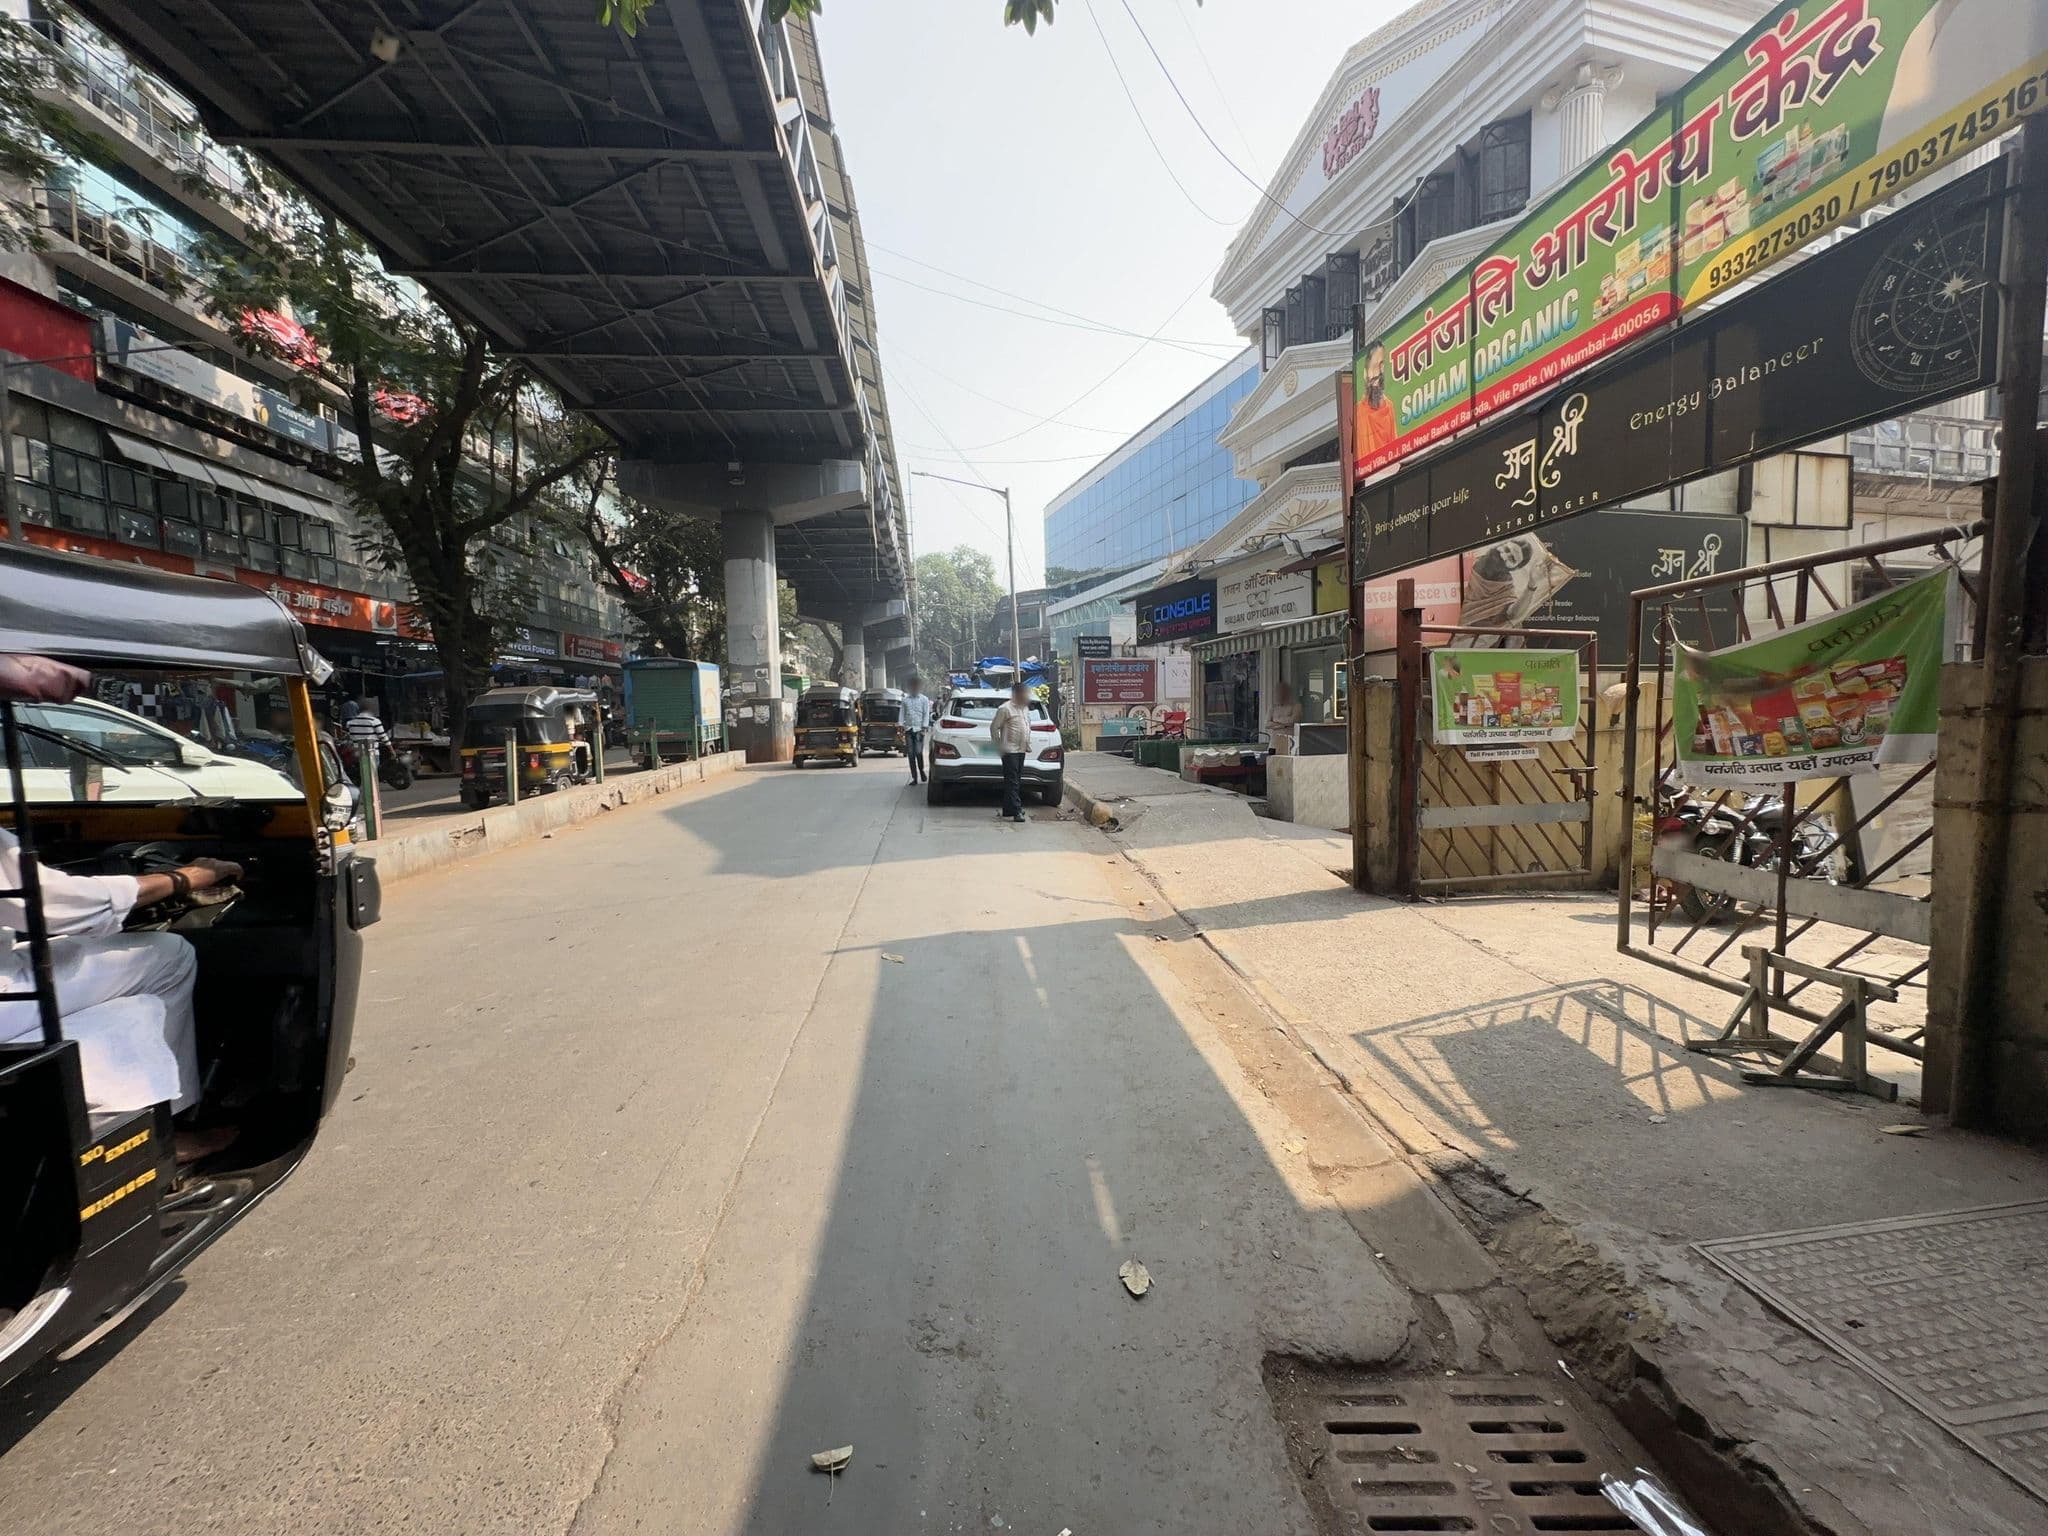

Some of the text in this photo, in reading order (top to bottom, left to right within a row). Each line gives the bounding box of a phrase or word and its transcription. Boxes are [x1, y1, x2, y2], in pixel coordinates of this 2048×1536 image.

[1390, 254, 1520, 386] पतंजलि
[1522, 98, 1725, 288] आरोग्य
[1709, 199, 1841, 290] 9332273030
[1400, 287, 1579, 426] SOHAM ORGANIC
[1413, 429, 1430, 446] Near
[1430, 418, 1450, 440] Bank
[1460, 399, 1492, 424] Baroda,
[1494, 389, 1511, 406] Vile
[1512, 374, 1538, 398] Parle
[1540, 362, 1559, 385] (W)
[1561, 304, 1662, 371] Mumbai-400056
[1708, 336, 1824, 400] Balancer
[1431, 497, 1452, 515] your
[1453, 488, 1470, 504] Life
[1486, 491, 1599, 536] ASTROLOGER
[1154, 592, 1211, 623] CONSOLE
[1246, 605, 1280, 621] OPTICIAN
[1557, 614, 1574, 622] Energy
[1575, 614, 1600, 622] Balancing
[1704, 751, 1873, 775] पतंजलि उत्पाद यहाँ उपलब्ध
[80, 1128, 151, 1167] NO ENTRY
